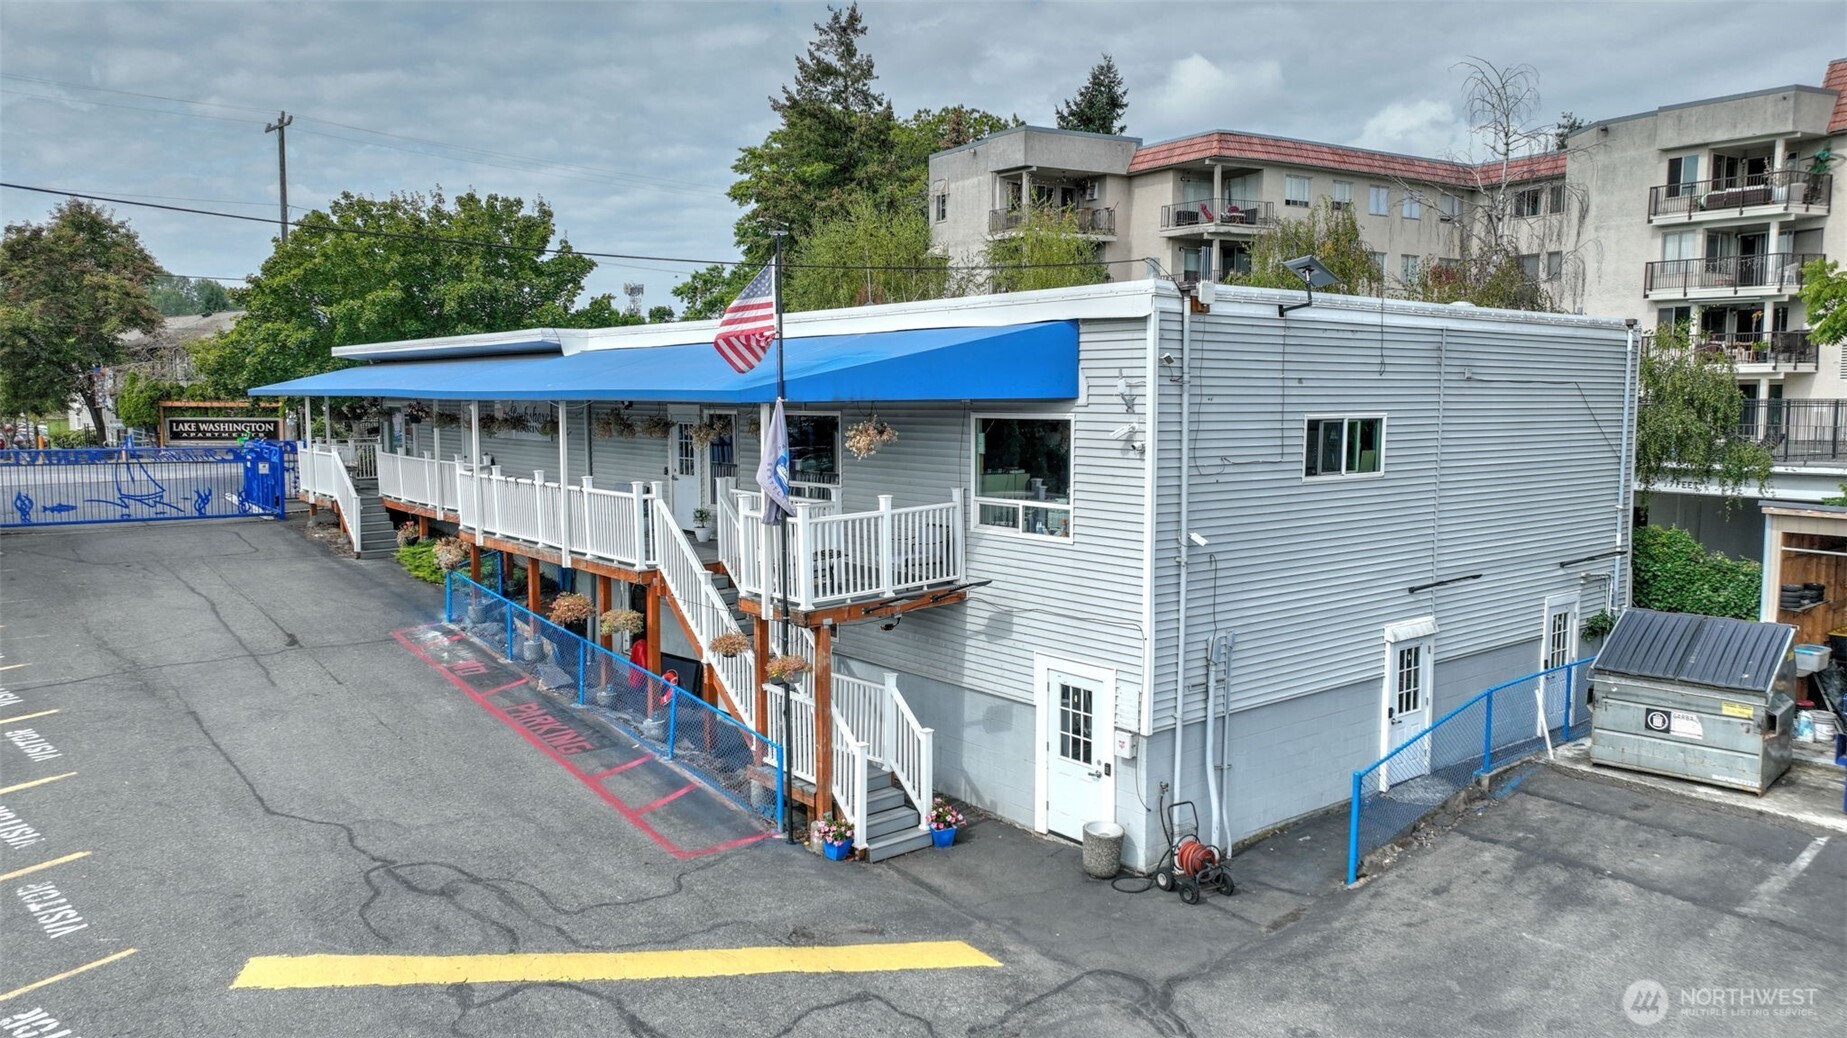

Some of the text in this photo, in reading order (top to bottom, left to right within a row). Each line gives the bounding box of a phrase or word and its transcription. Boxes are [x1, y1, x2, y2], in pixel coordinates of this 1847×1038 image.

[172, 422, 275, 432] LAKE WASHINGTON
[5, 728, 62, 761] VISITOR
[501, 702, 595, 755] PARKING
[0, 805, 46, 850] VISIT
[16, 881, 89, 939] VISITOR
